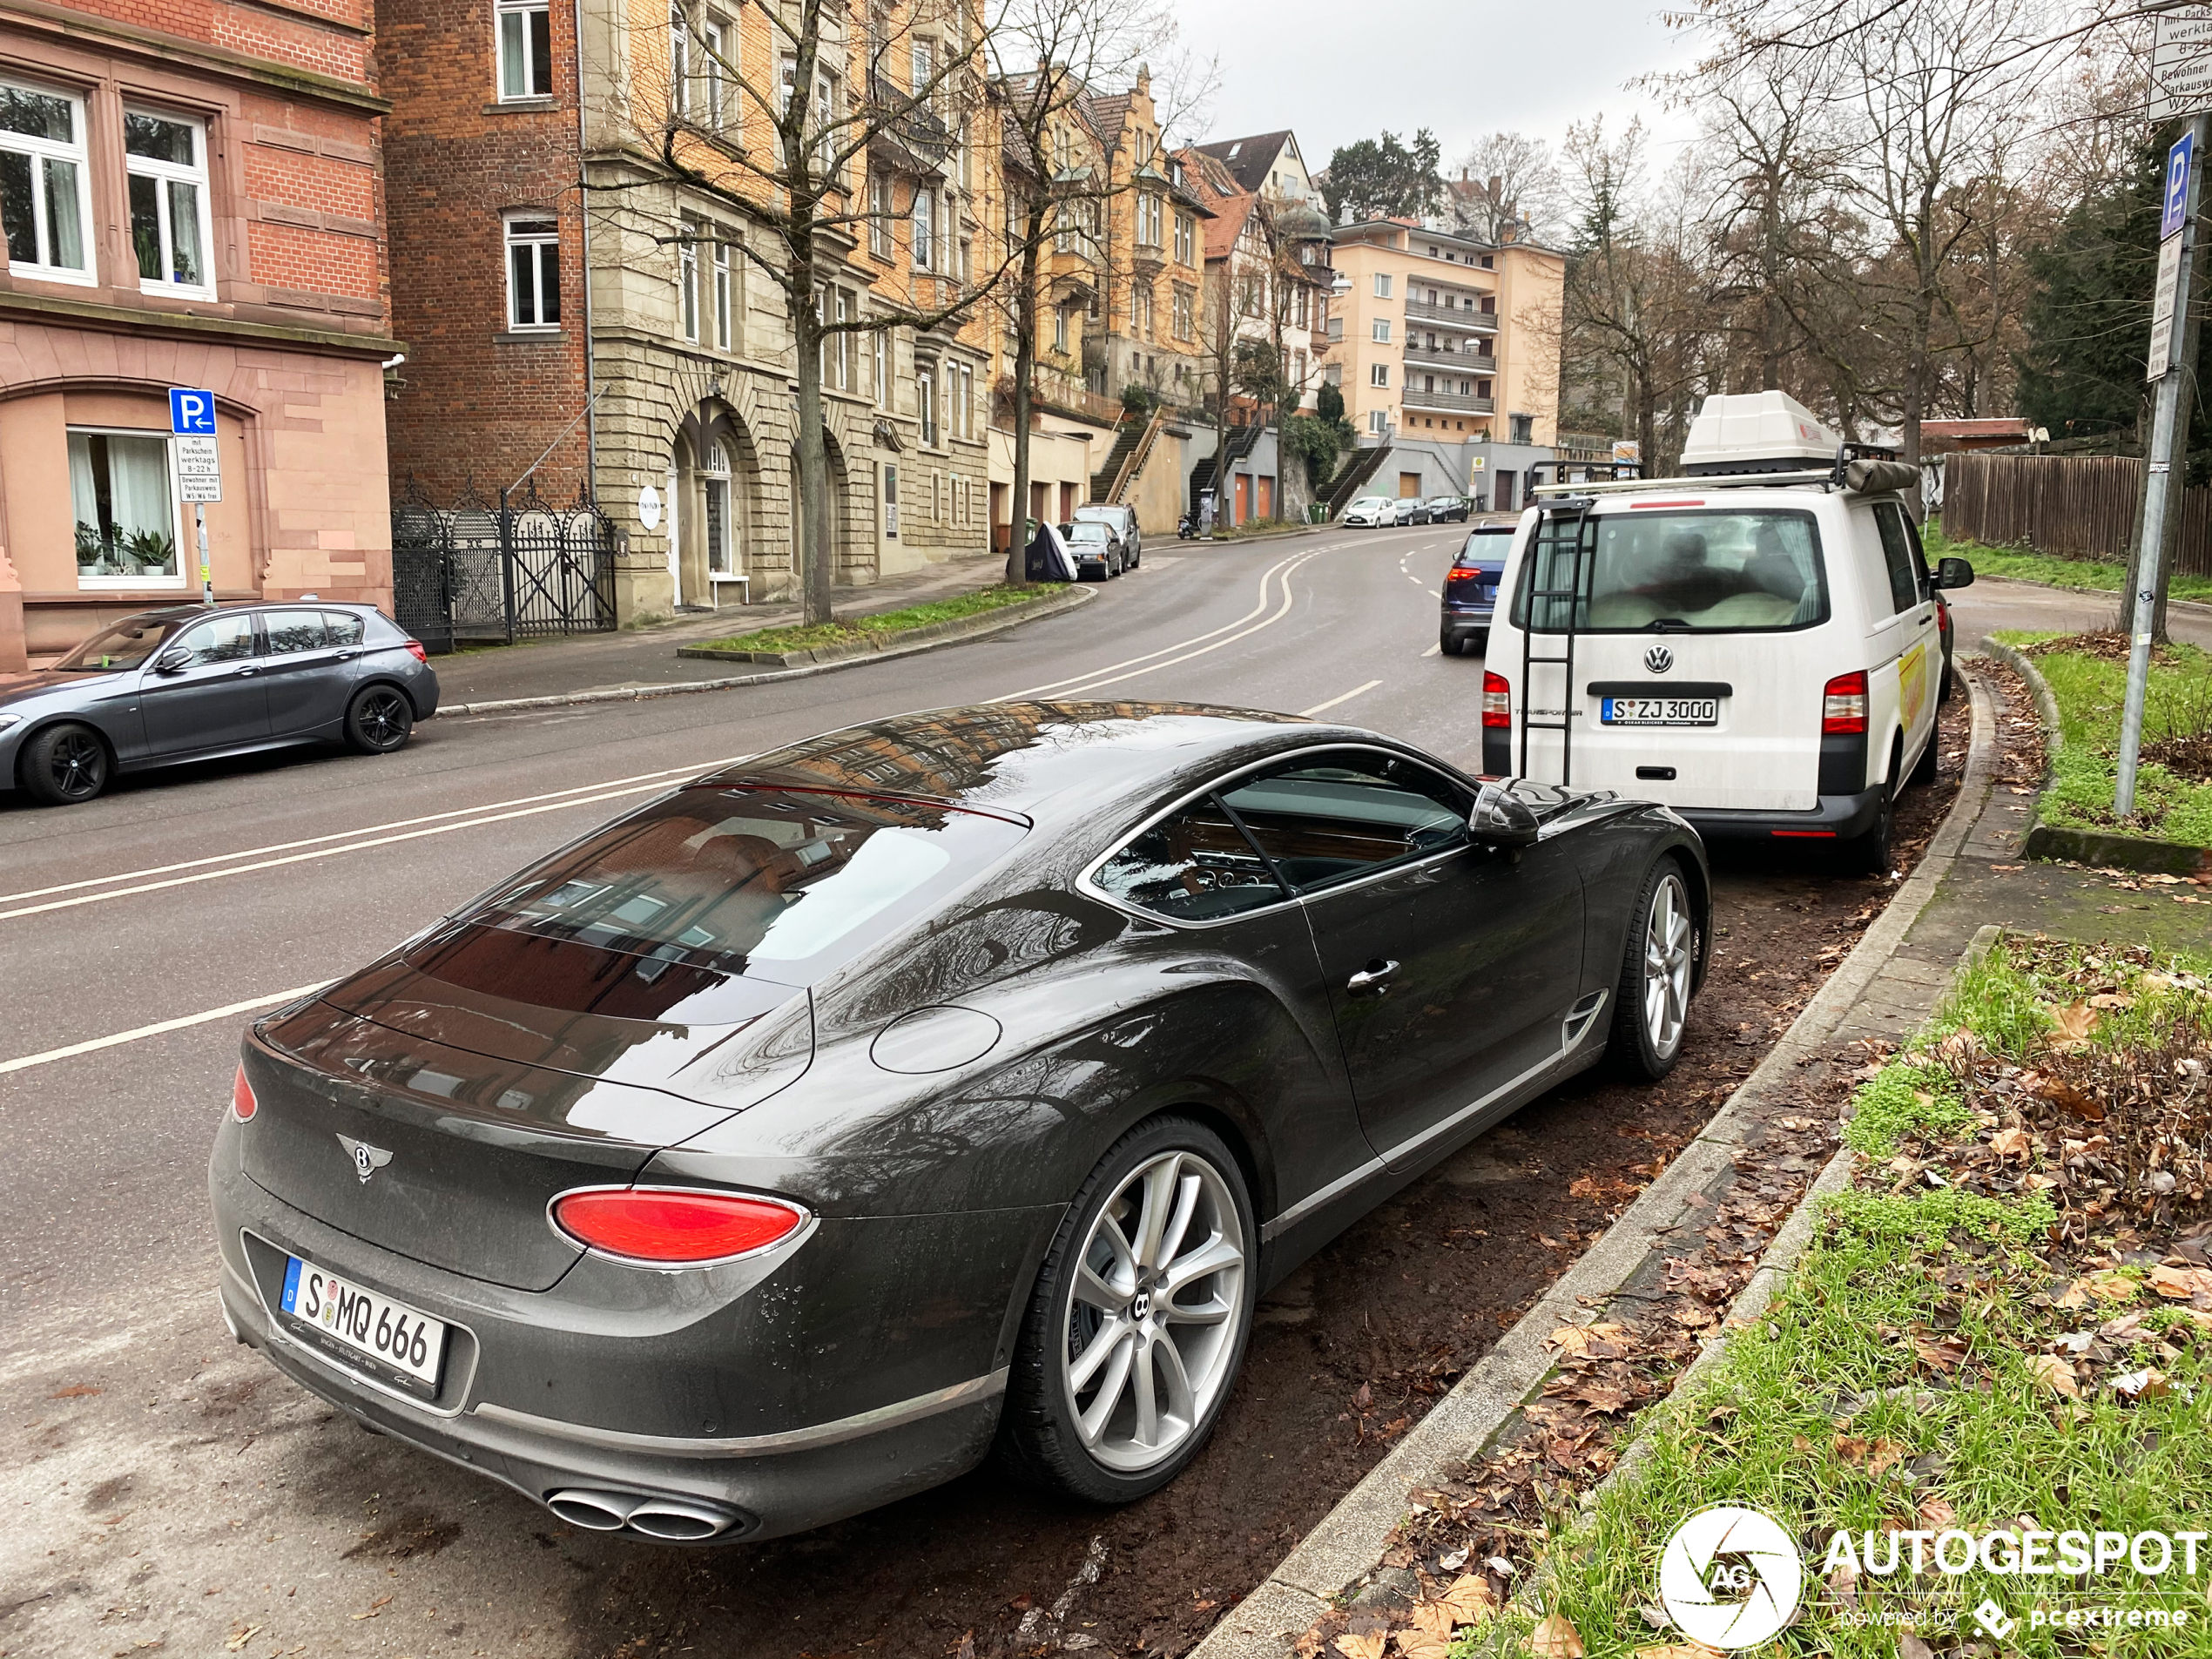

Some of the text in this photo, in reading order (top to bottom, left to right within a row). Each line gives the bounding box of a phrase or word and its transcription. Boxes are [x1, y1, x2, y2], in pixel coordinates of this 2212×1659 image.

[2161, 64, 2209, 82] Bewohner
[2167, 151, 2185, 225] P
[180, 395, 204, 428] P
[180, 456, 216, 465] werktags
[1614, 701, 1714, 718] S ZJ 3000
[287, 1289, 293, 1302] D
[306, 1273, 427, 1367] S MQ 666
[320, 1337, 335, 1349] SINGEN
[338, 1347, 361, 1363] STUTTGART
[365, 1359, 376, 1370] WIEN
